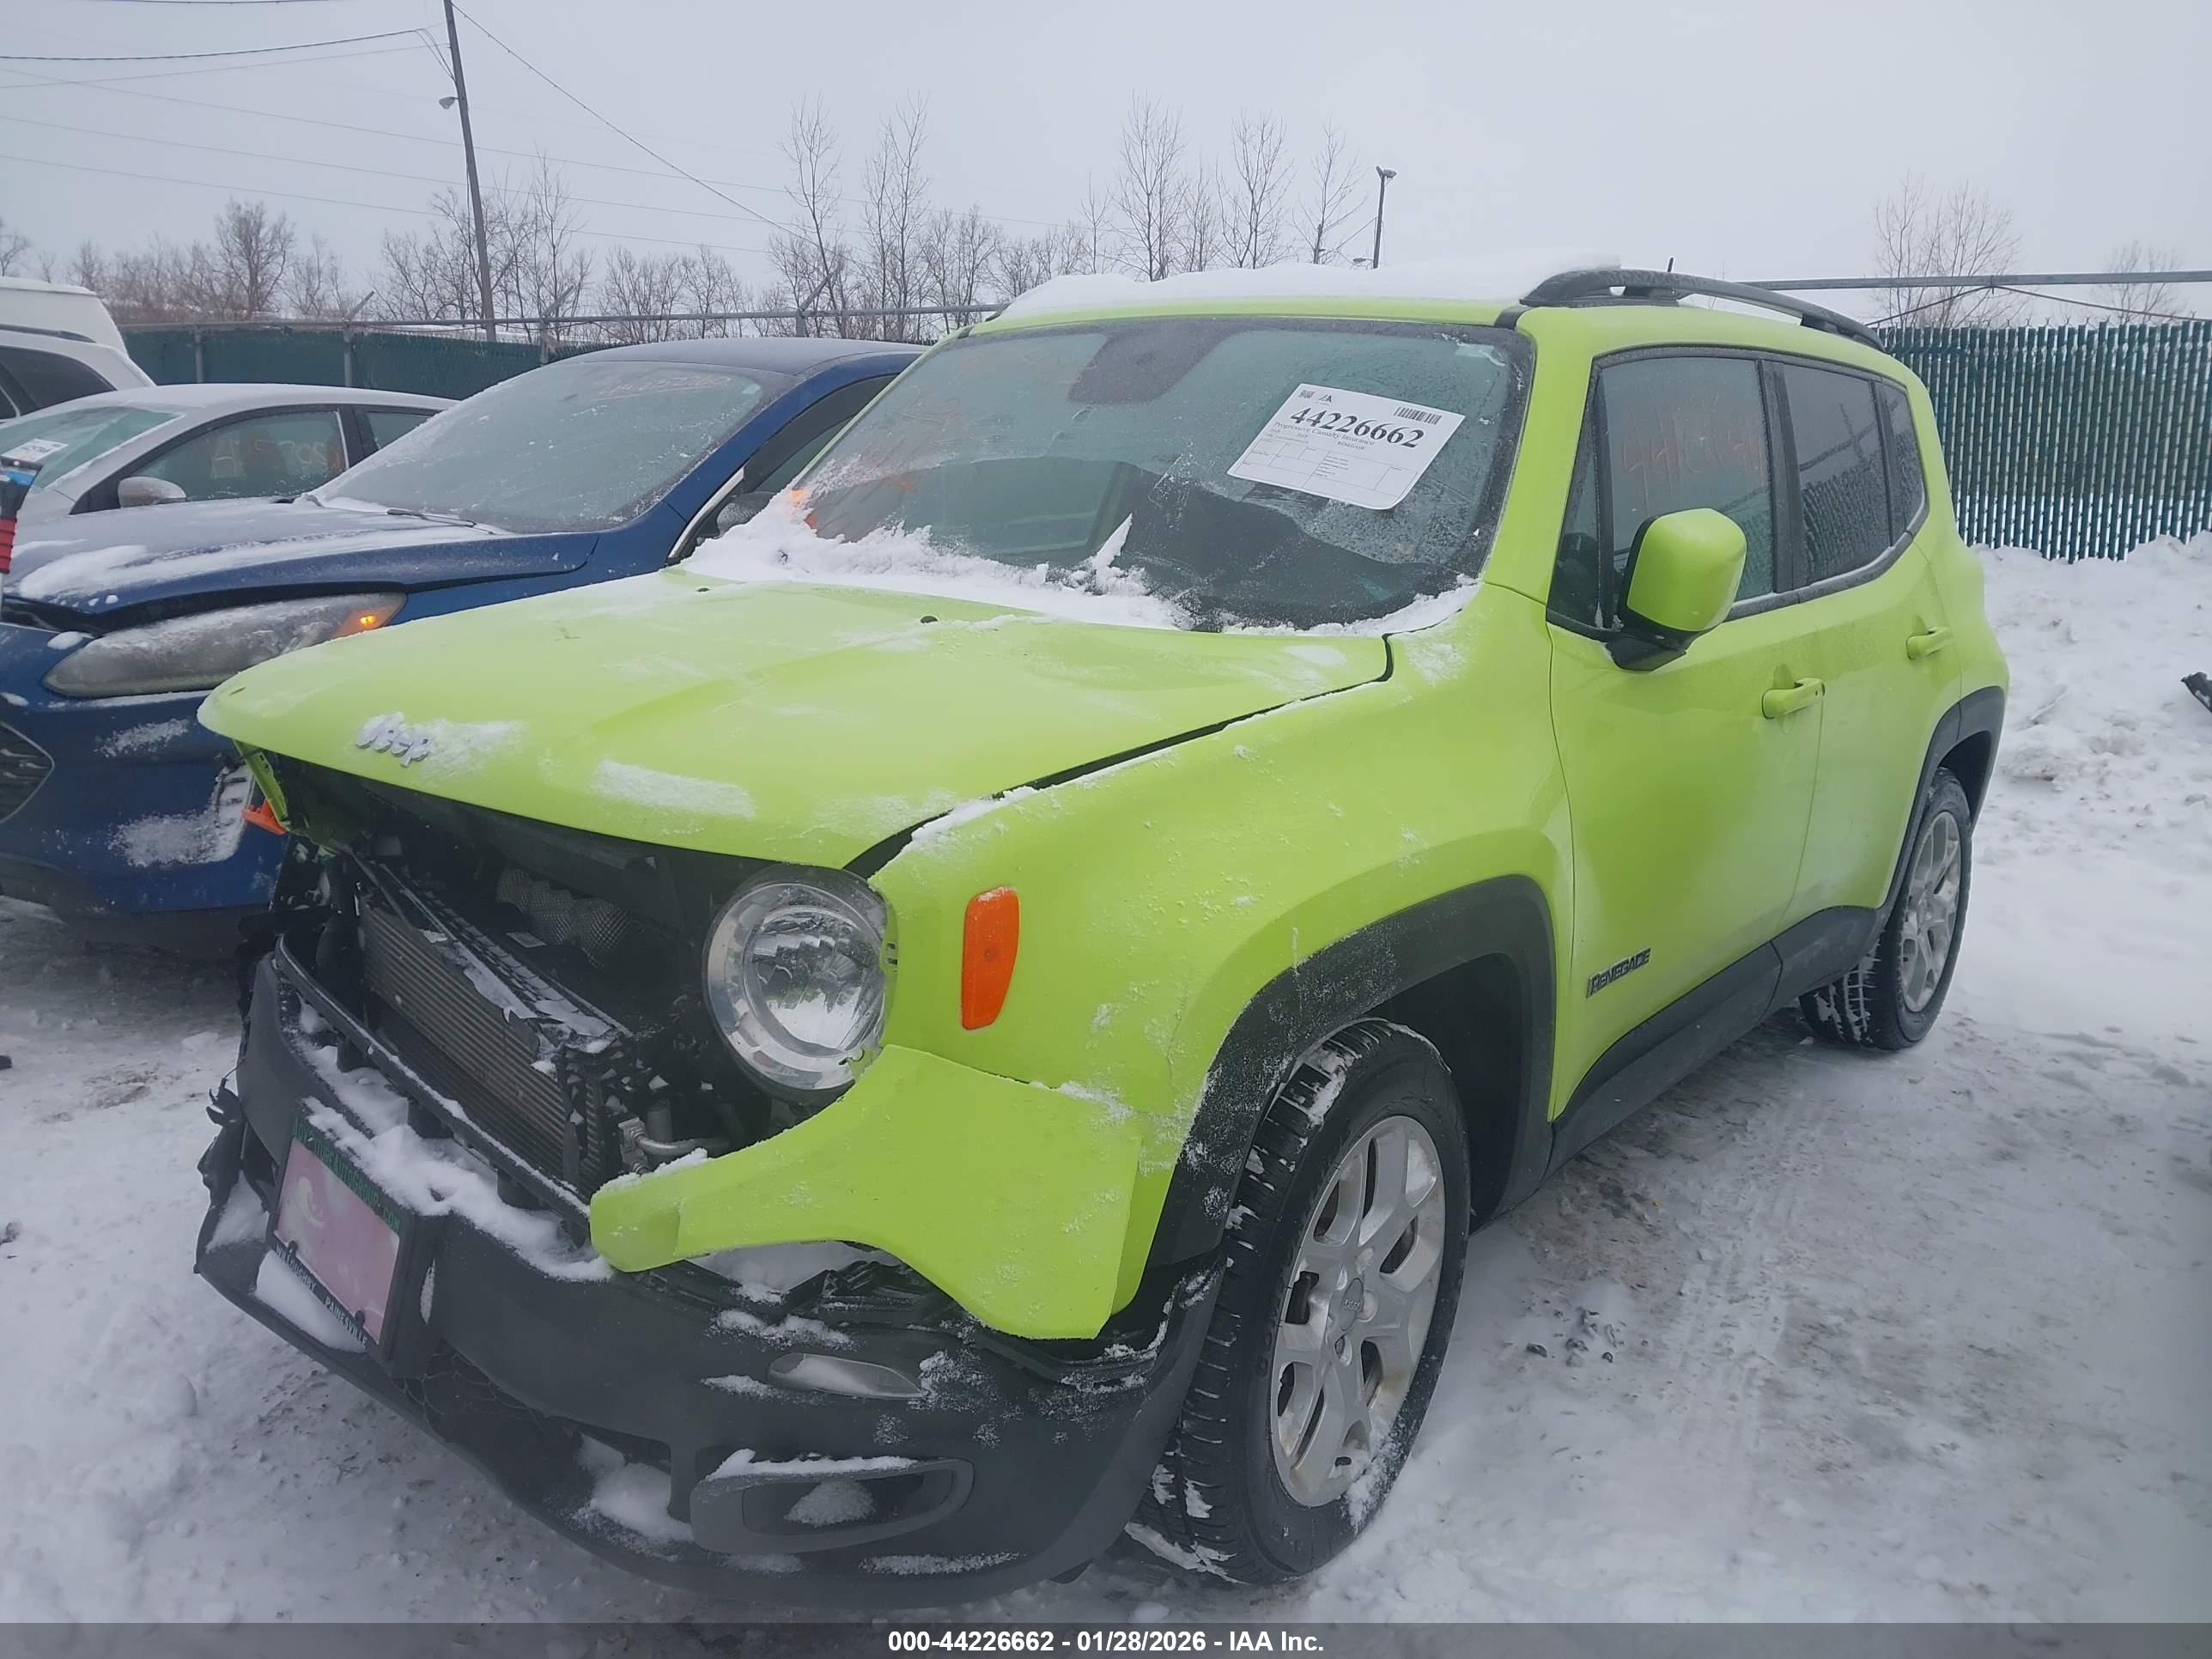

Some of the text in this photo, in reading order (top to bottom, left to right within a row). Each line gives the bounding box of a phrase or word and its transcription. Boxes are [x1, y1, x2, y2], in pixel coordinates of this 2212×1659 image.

[1291, 407, 1425, 448] 44226662
[1311, 428, 1341, 441] Casualty
[1341, 434, 1376, 447] Insurance
[1586, 947, 1651, 999] RENEGADE
[325, 1297, 368, 1349] PAINESVILLE
